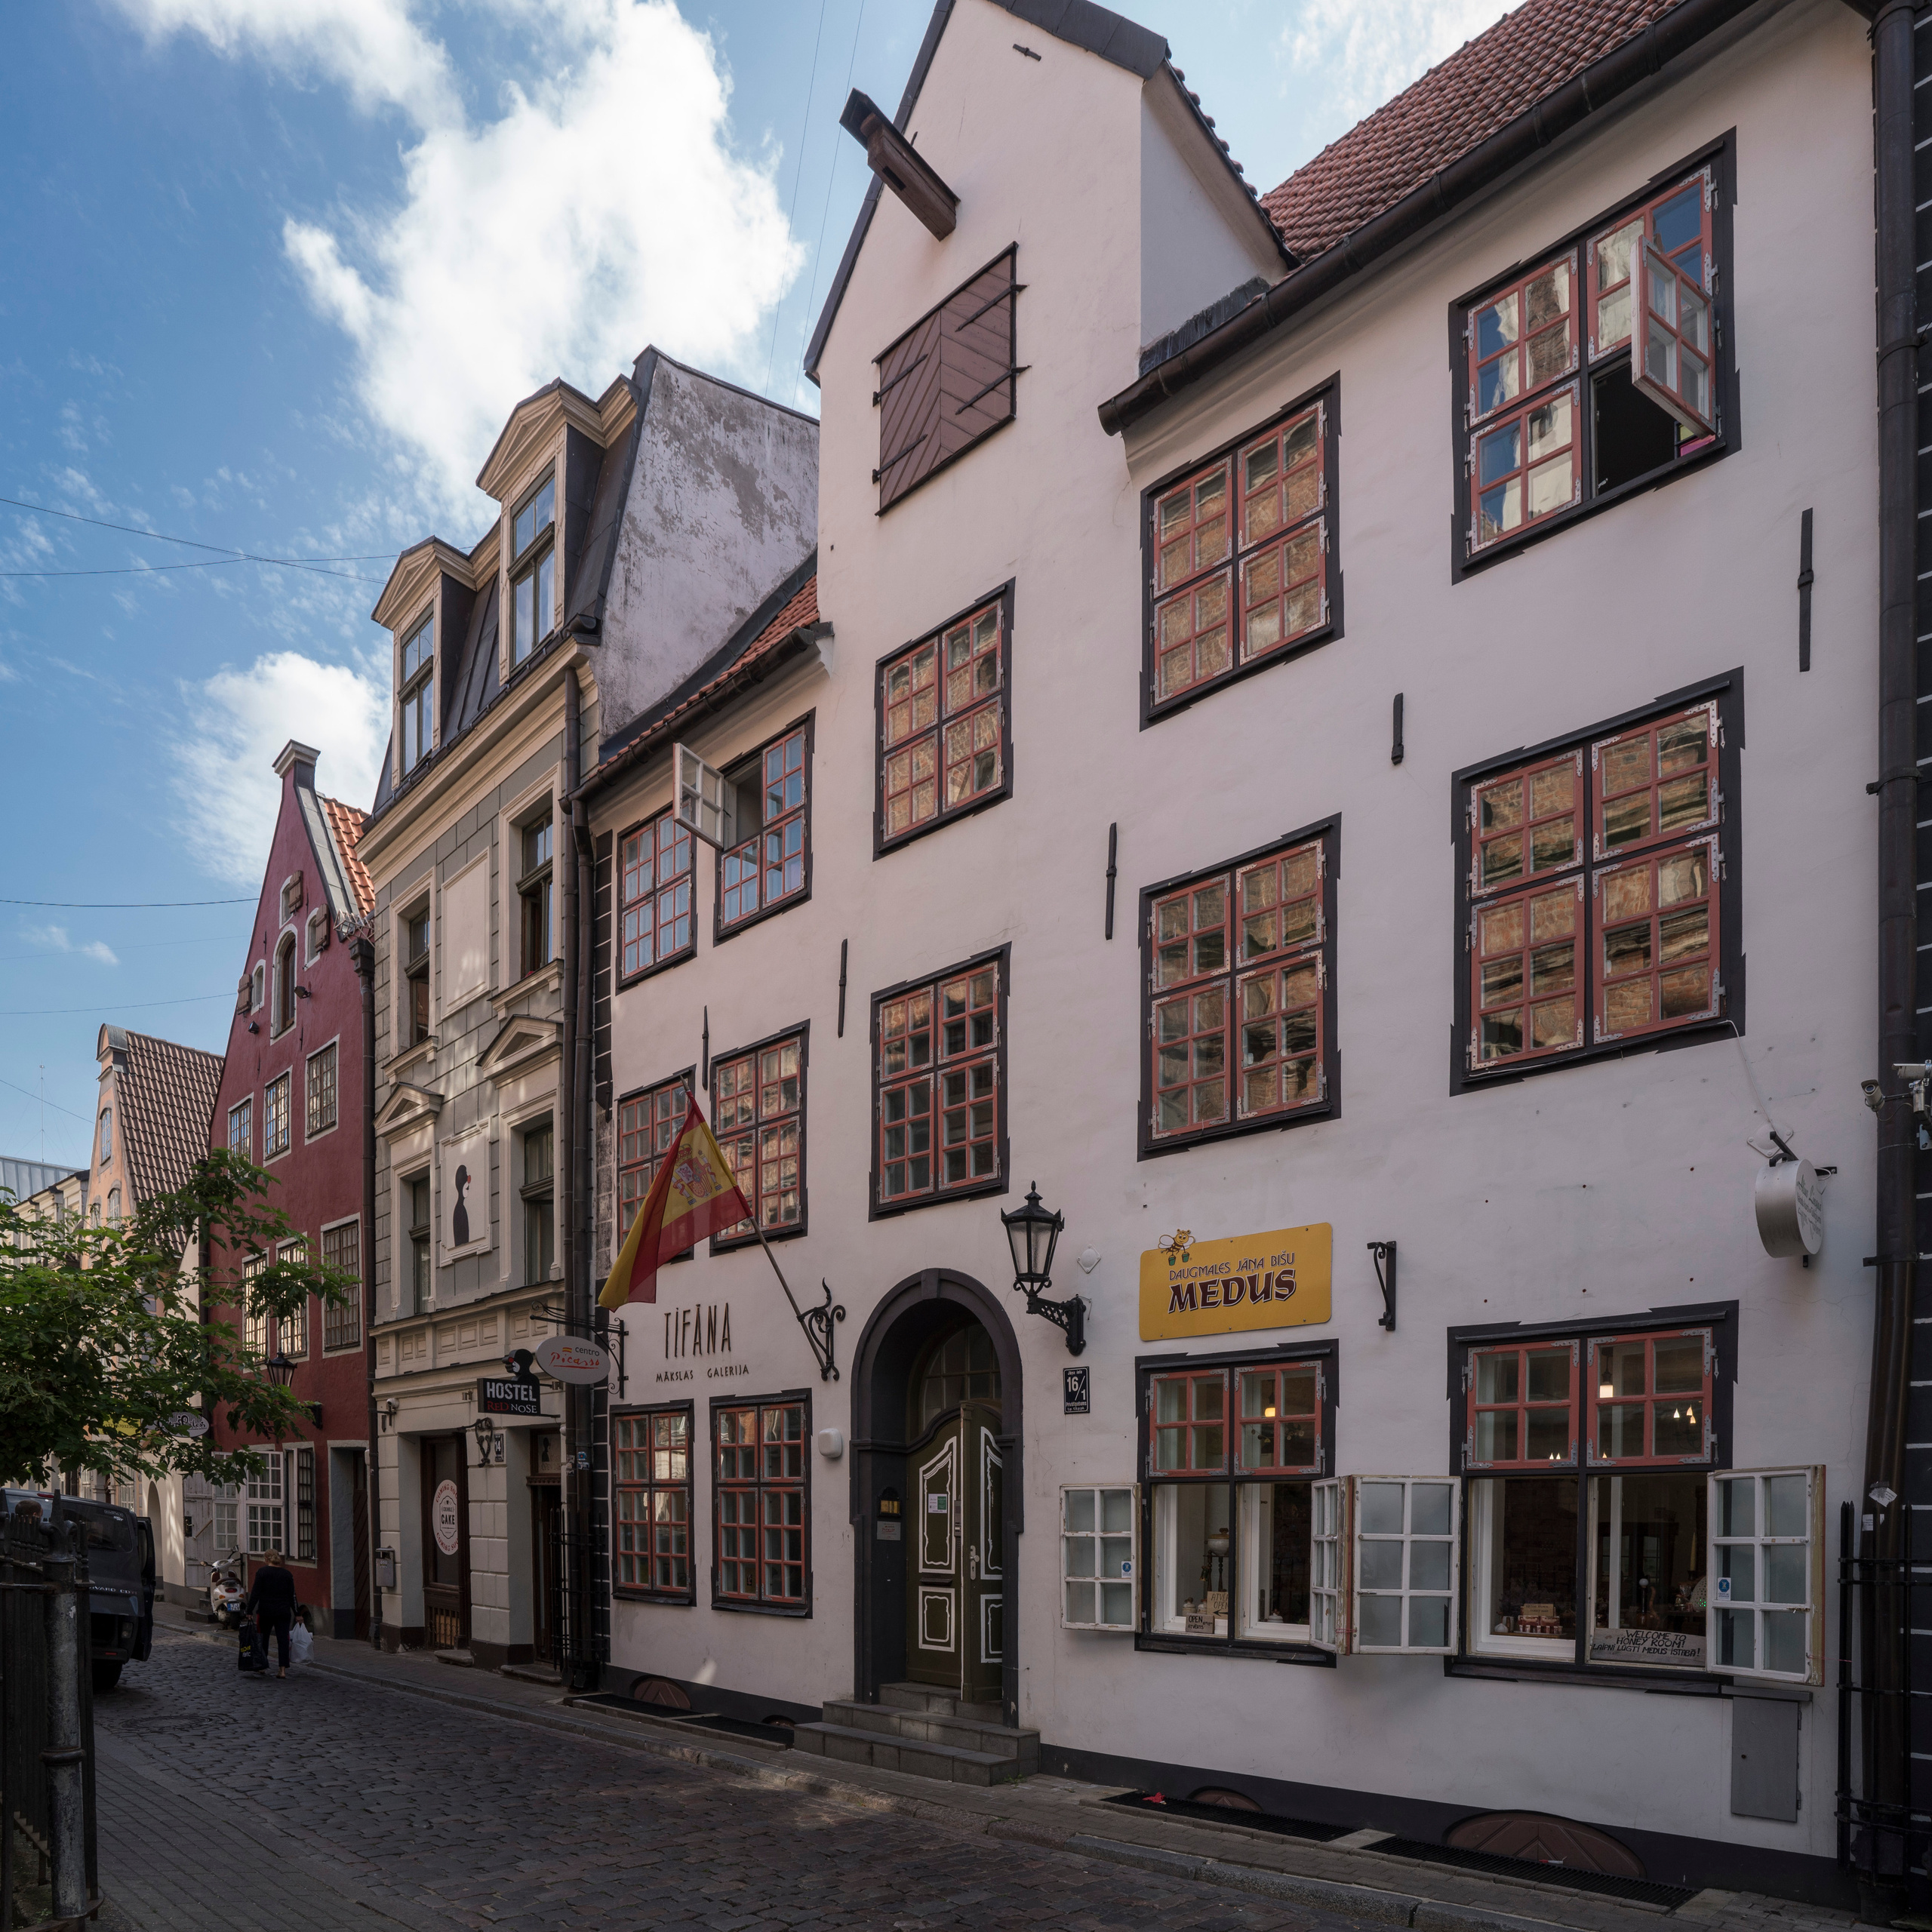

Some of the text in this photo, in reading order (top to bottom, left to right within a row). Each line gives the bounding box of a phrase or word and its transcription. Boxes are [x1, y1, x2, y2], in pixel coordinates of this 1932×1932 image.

[1169, 1250, 1295, 1281] DAUGMALES JĀŅA BIŠU
[1168, 1268, 1297, 1314] MEDUS
[574, 1346, 600, 1357] centro
[549, 1352, 600, 1367] Picasso
[656, 1364, 749, 1383] MĀKSLAS GALERIJA
[486, 1381, 537, 1402] HOSTEL
[441, 1514, 455, 1524] CAKE
[1617, 1637, 1685, 1648] HONEY ROOM!
[1626, 1630, 1672, 1640] WELCOME
